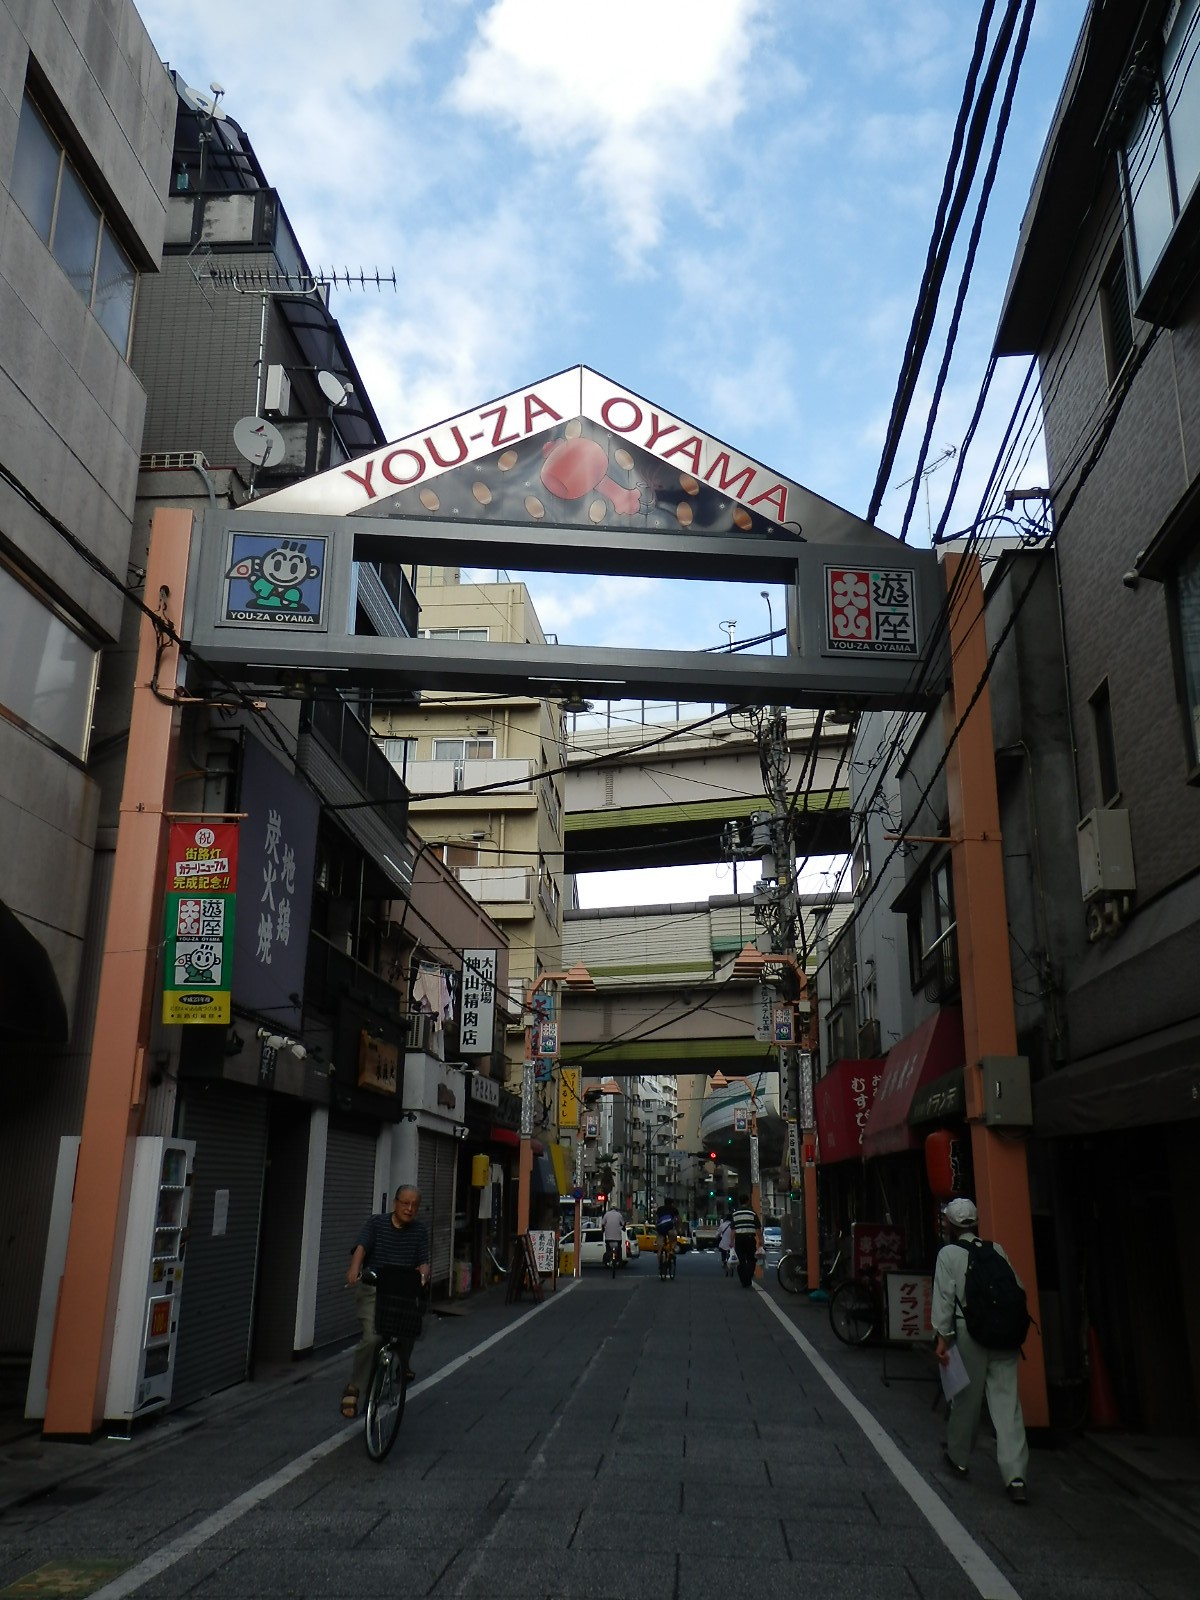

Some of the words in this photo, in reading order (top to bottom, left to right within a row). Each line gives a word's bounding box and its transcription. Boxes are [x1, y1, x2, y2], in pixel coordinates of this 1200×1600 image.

[344, 394, 563, 500] YOU-ZA
[600, 396, 789, 523] OYAMA
[231, 611, 270, 621] YOU-ZA
[275, 614, 314, 623] OYAMA
[873, 573, 910, 642] 遊座
[832, 641, 870, 650] YOU-ZA
[874, 643, 911, 652] OYAMA
[199, 831, 212, 844] 祝
[186, 848, 222, 860] 街路灯
[179, 861, 226, 875] カラーリニューアル
[201, 900, 222, 935] 遊座
[481, 957, 493, 1004] 大山酒場
[462, 957, 481, 1045] 神山精肉店
